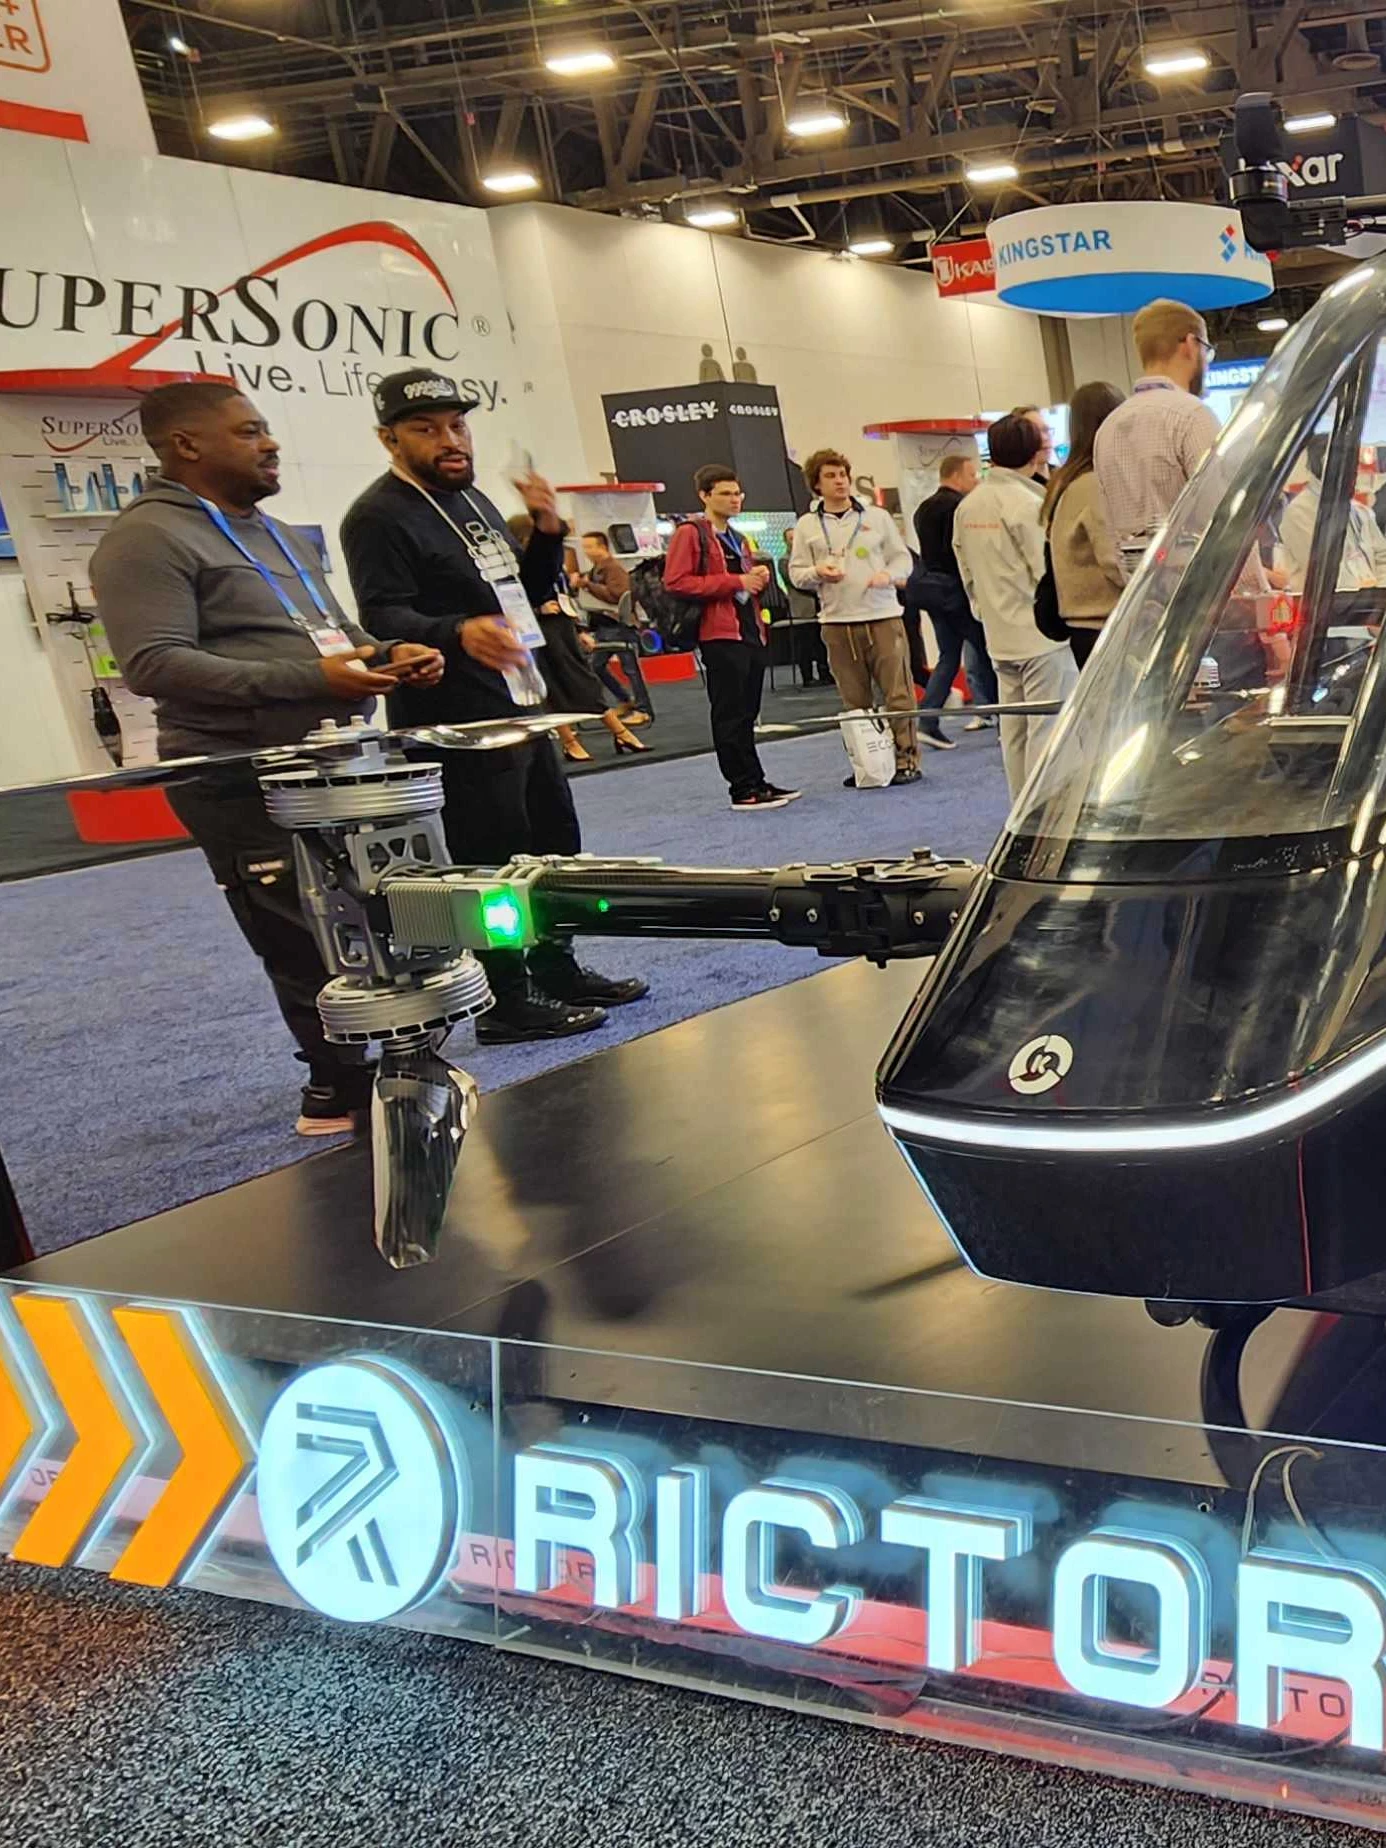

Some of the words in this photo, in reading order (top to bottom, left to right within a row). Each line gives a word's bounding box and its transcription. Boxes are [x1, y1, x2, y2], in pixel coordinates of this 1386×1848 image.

[1239, 153, 1344, 187] xar
[999, 230, 1112, 267] KINGSTAR
[0, 268, 459, 362] UPERSONIC
[612, 401, 719, 427] CROSLEY
[729, 404, 778, 417] CROSLEY
[42, 416, 139, 437] SUPERSO
